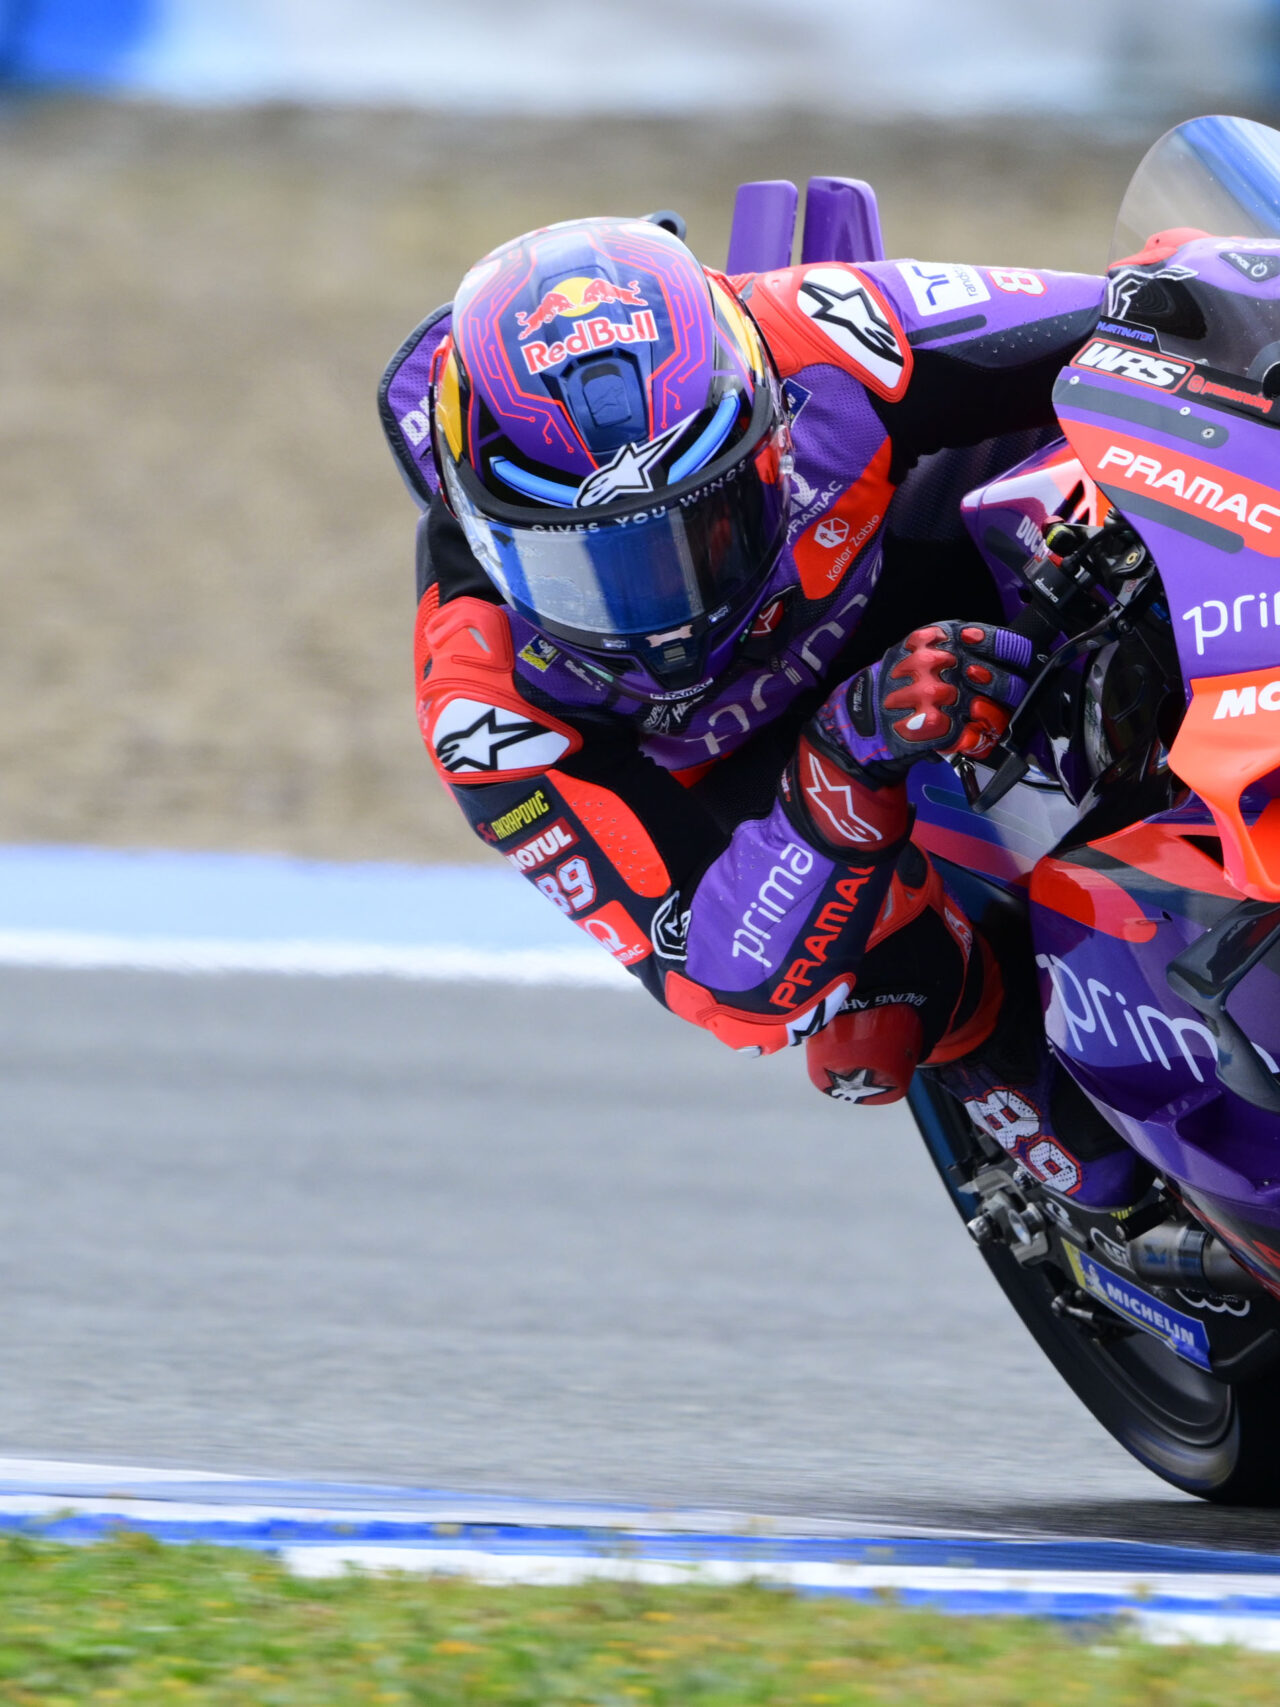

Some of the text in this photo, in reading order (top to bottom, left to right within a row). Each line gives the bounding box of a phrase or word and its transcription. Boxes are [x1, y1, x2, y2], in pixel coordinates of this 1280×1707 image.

[1076, 342, 1187, 388] WRS
[531, 522, 600, 535] GIVES
[614, 505, 667, 529] YOU
[732, 842, 814, 969] prima
[1035, 953, 1280, 1084] prim
[1106, 1281, 1196, 1348] MICHELIN
